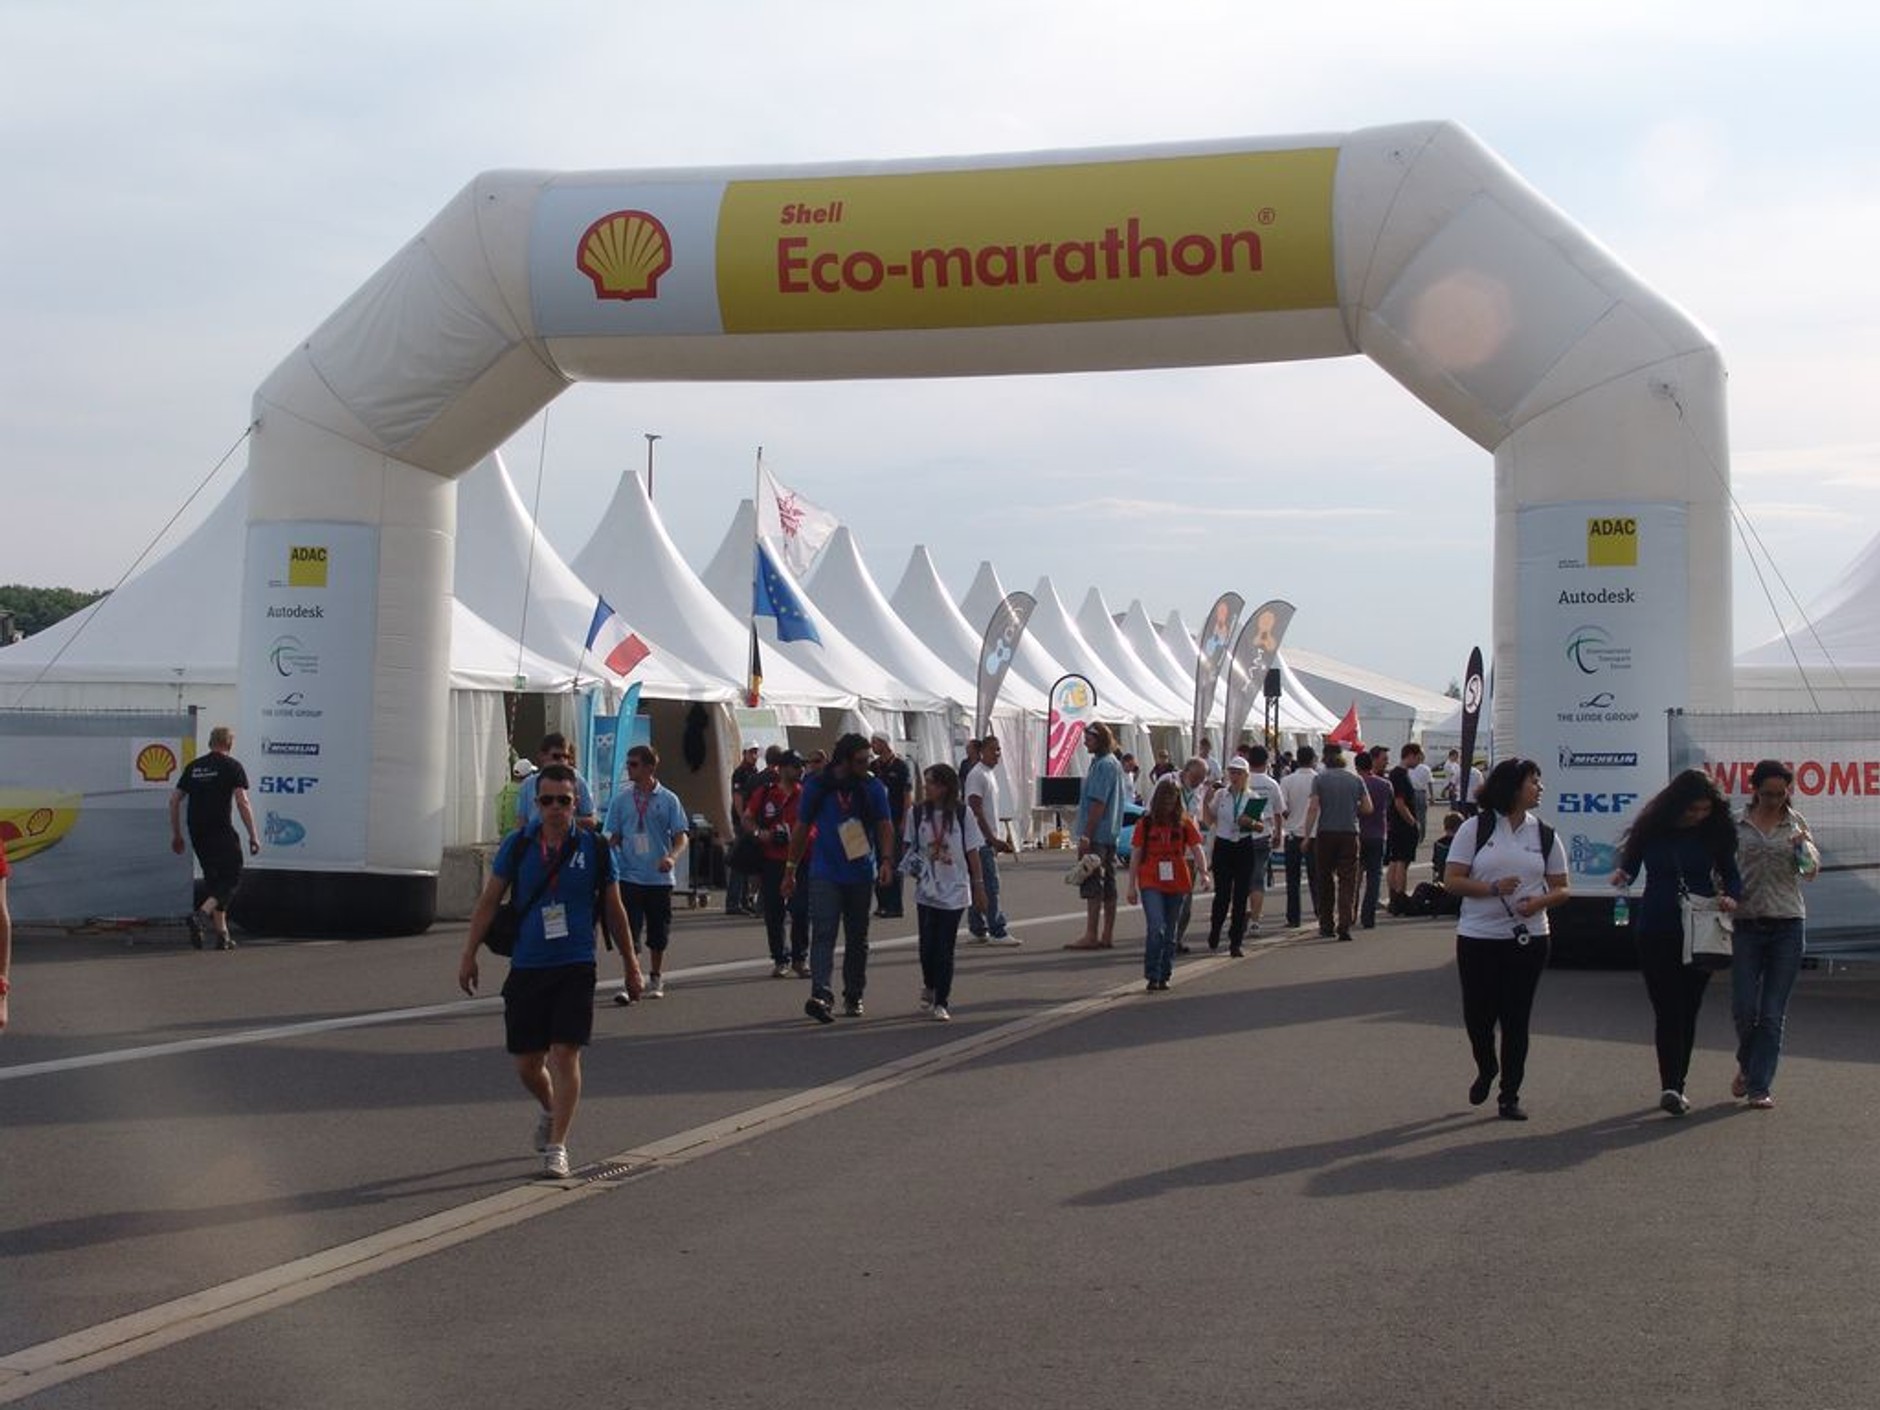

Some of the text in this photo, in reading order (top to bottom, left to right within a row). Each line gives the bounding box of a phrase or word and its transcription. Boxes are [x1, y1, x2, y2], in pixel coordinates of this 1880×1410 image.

[780, 201, 843, 225] Shell
[1590, 519, 1636, 536] ADAC
[291, 547, 327, 562] ADAC
[1558, 587, 1636, 604] Autodesk
[266, 605, 324, 618] Autodesk
[1557, 713, 1574, 721] THE
[1604, 712, 1639, 721] GROUP
[1574, 755, 1635, 763] MICHELIN
[259, 776, 319, 794] SKF
[1703, 761, 1880, 796] WEOME
[1557, 793, 1639, 813] SKF
